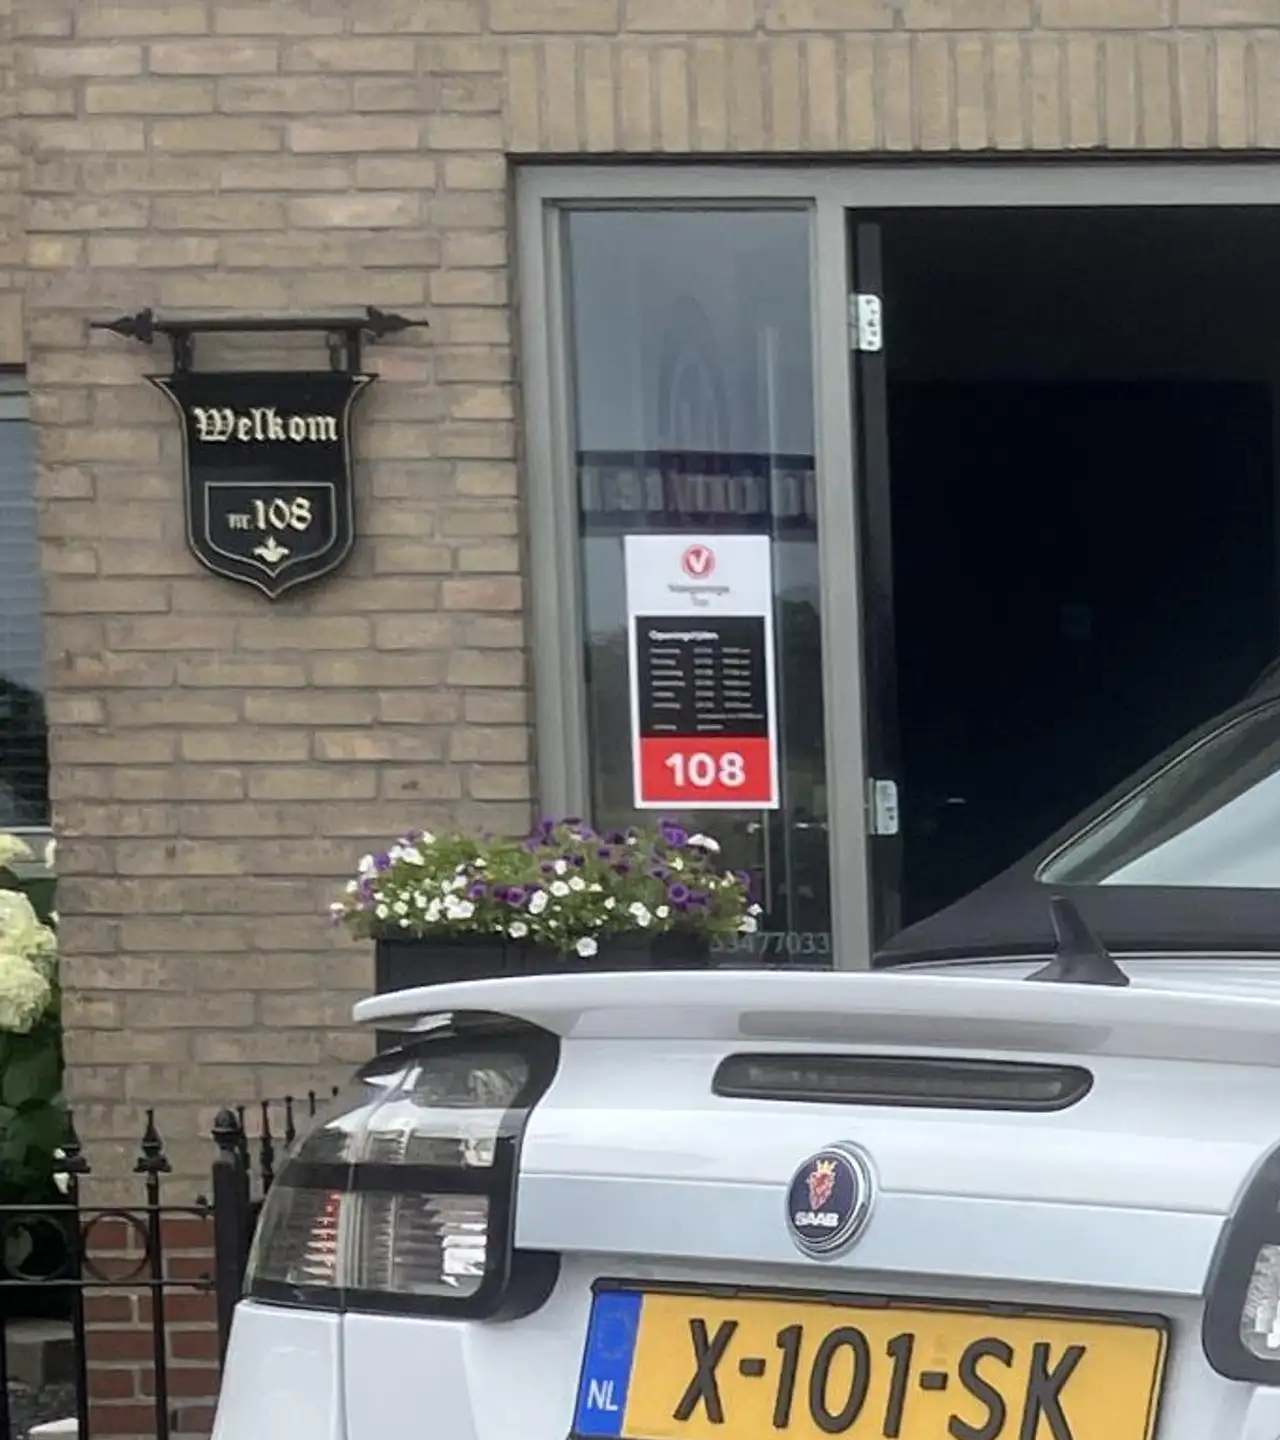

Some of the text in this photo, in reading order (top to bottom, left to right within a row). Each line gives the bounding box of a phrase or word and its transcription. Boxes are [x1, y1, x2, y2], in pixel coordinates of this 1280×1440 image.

[195, 407, 339, 443] Welkom
[253, 497, 312, 531] 108
[664, 752, 746, 788] 108
[794, 1211, 839, 1227] SAAB
[588, 1381, 619, 1412] NL
